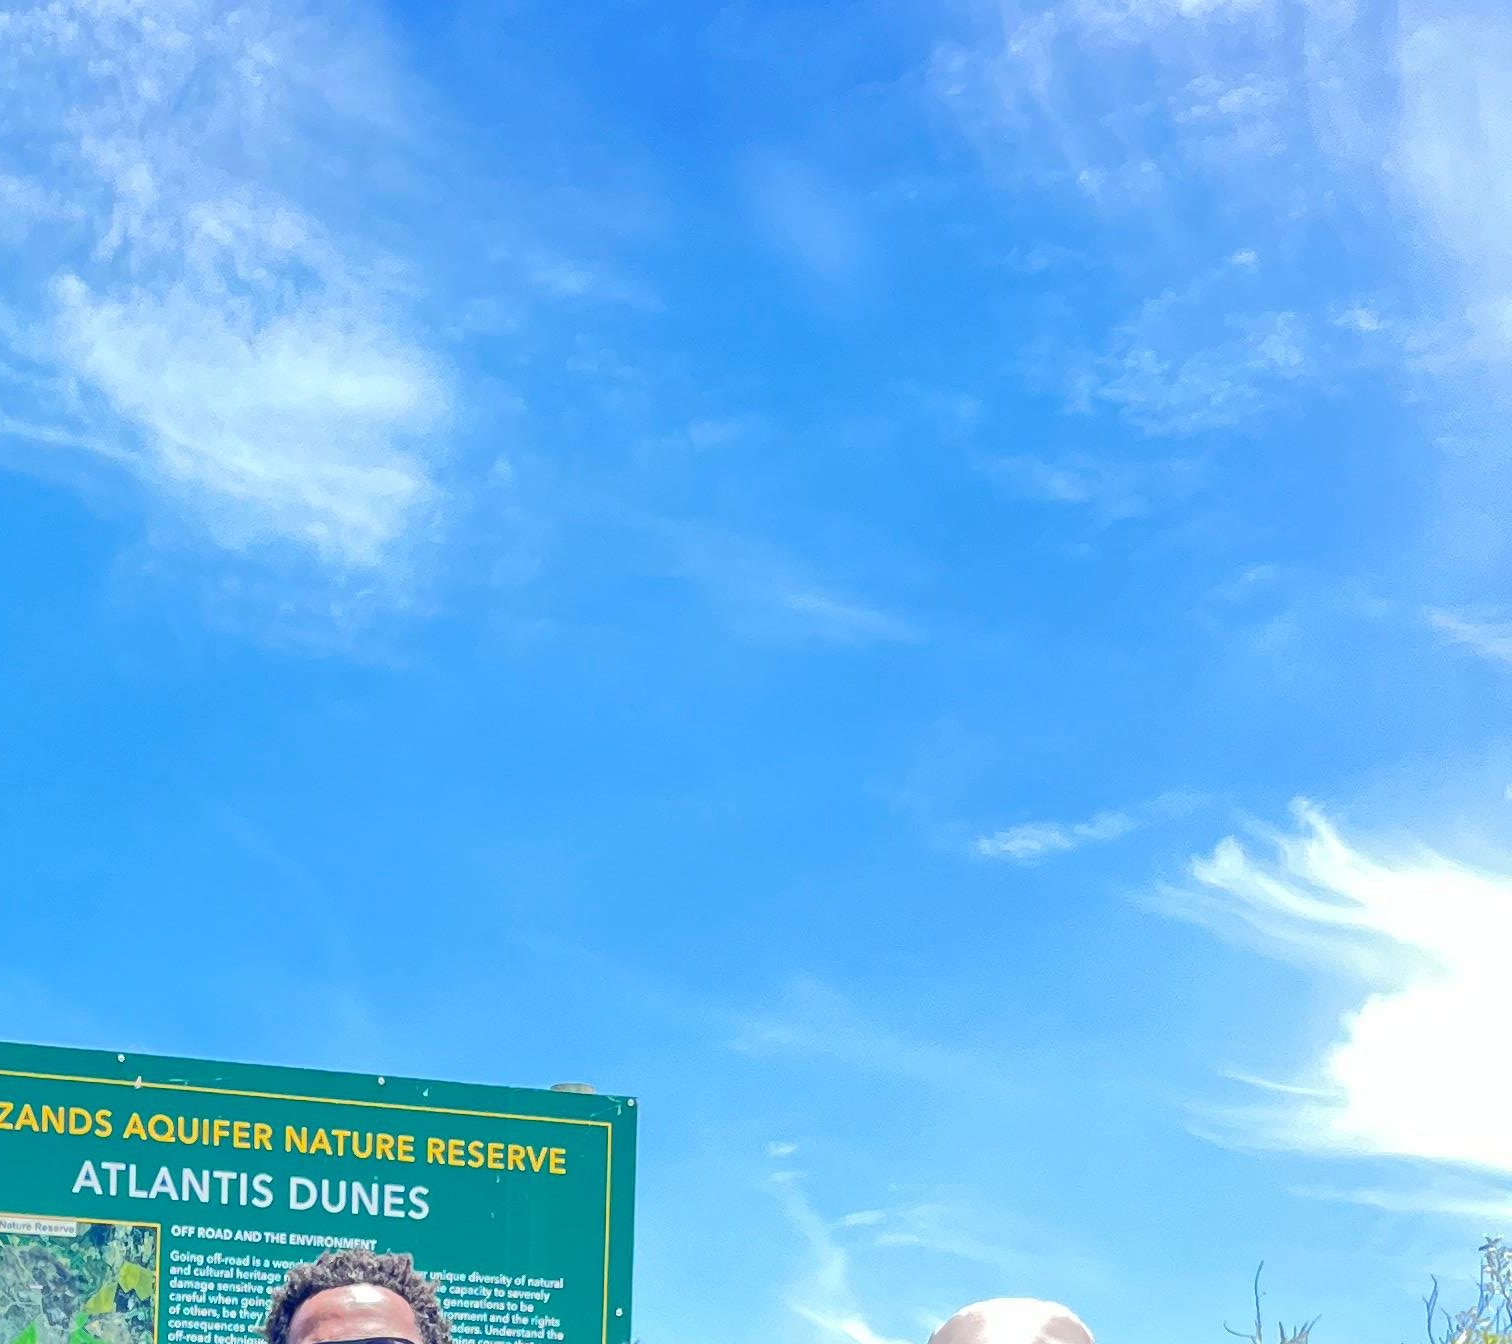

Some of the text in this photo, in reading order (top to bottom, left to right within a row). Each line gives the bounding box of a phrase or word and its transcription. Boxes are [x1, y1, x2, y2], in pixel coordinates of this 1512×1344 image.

[122, 1112, 273, 1151] AQUIFER
[284, 1125, 416, 1163] NATURE
[427, 1137, 567, 1175] RESERVE
[71, 1159, 430, 1220] ATLANTIS DUNES
[0, 1219, 32, 1231] Nature
[34, 1222, 75, 1234] Reserve
[171, 1225, 377, 1250] OFF ROAD AND THE ENVIRONMENT
[169, 1265, 191, 1275] and
[193, 1266, 234, 1279] cultural
[236, 1270, 281, 1284] heritage
[449, 1285, 492, 1298] capacity
[494, 1287, 505, 1298] to
[507, 1289, 551, 1304] severely
[170, 1250, 204, 1265] Going
[206, 1252, 250, 1267] off-road
[252, 1256, 261, 1267] is
[263, 1259, 270, 1268] a
[430, 1269, 467, 1284] unique
[468, 1272, 513, 1287] diversity
[514, 1274, 527, 1286] of
[528, 1277, 564, 1289] natural
[169, 1276, 214, 1292] damage
[217, 1281, 263, 1294] sensitive
[443, 1298, 505, 1311] generations
[507, 1300, 519, 1312] to
[519, 1301, 534, 1313] be
[169, 1291, 206, 1303] careful
[208, 1294, 238, 1305] when
[240, 1296, 272, 1310] going
[489, 1313, 510, 1324] and
[511, 1314, 529, 1325] the
[530, 1315, 561, 1329] rights
[168, 1304, 181, 1315] of
[183, 1305, 220, 1318] others,
[222, 1307, 237, 1319] be
[239, 1308, 263, 1322] they
[450, 1323, 483, 1335] aders.
[484, 1324, 545, 1339] Understand
[546, 1329, 565, 1341] the
[168, 1320, 245, 1332] consequences
[168, 1330, 211, 1343] off-road
